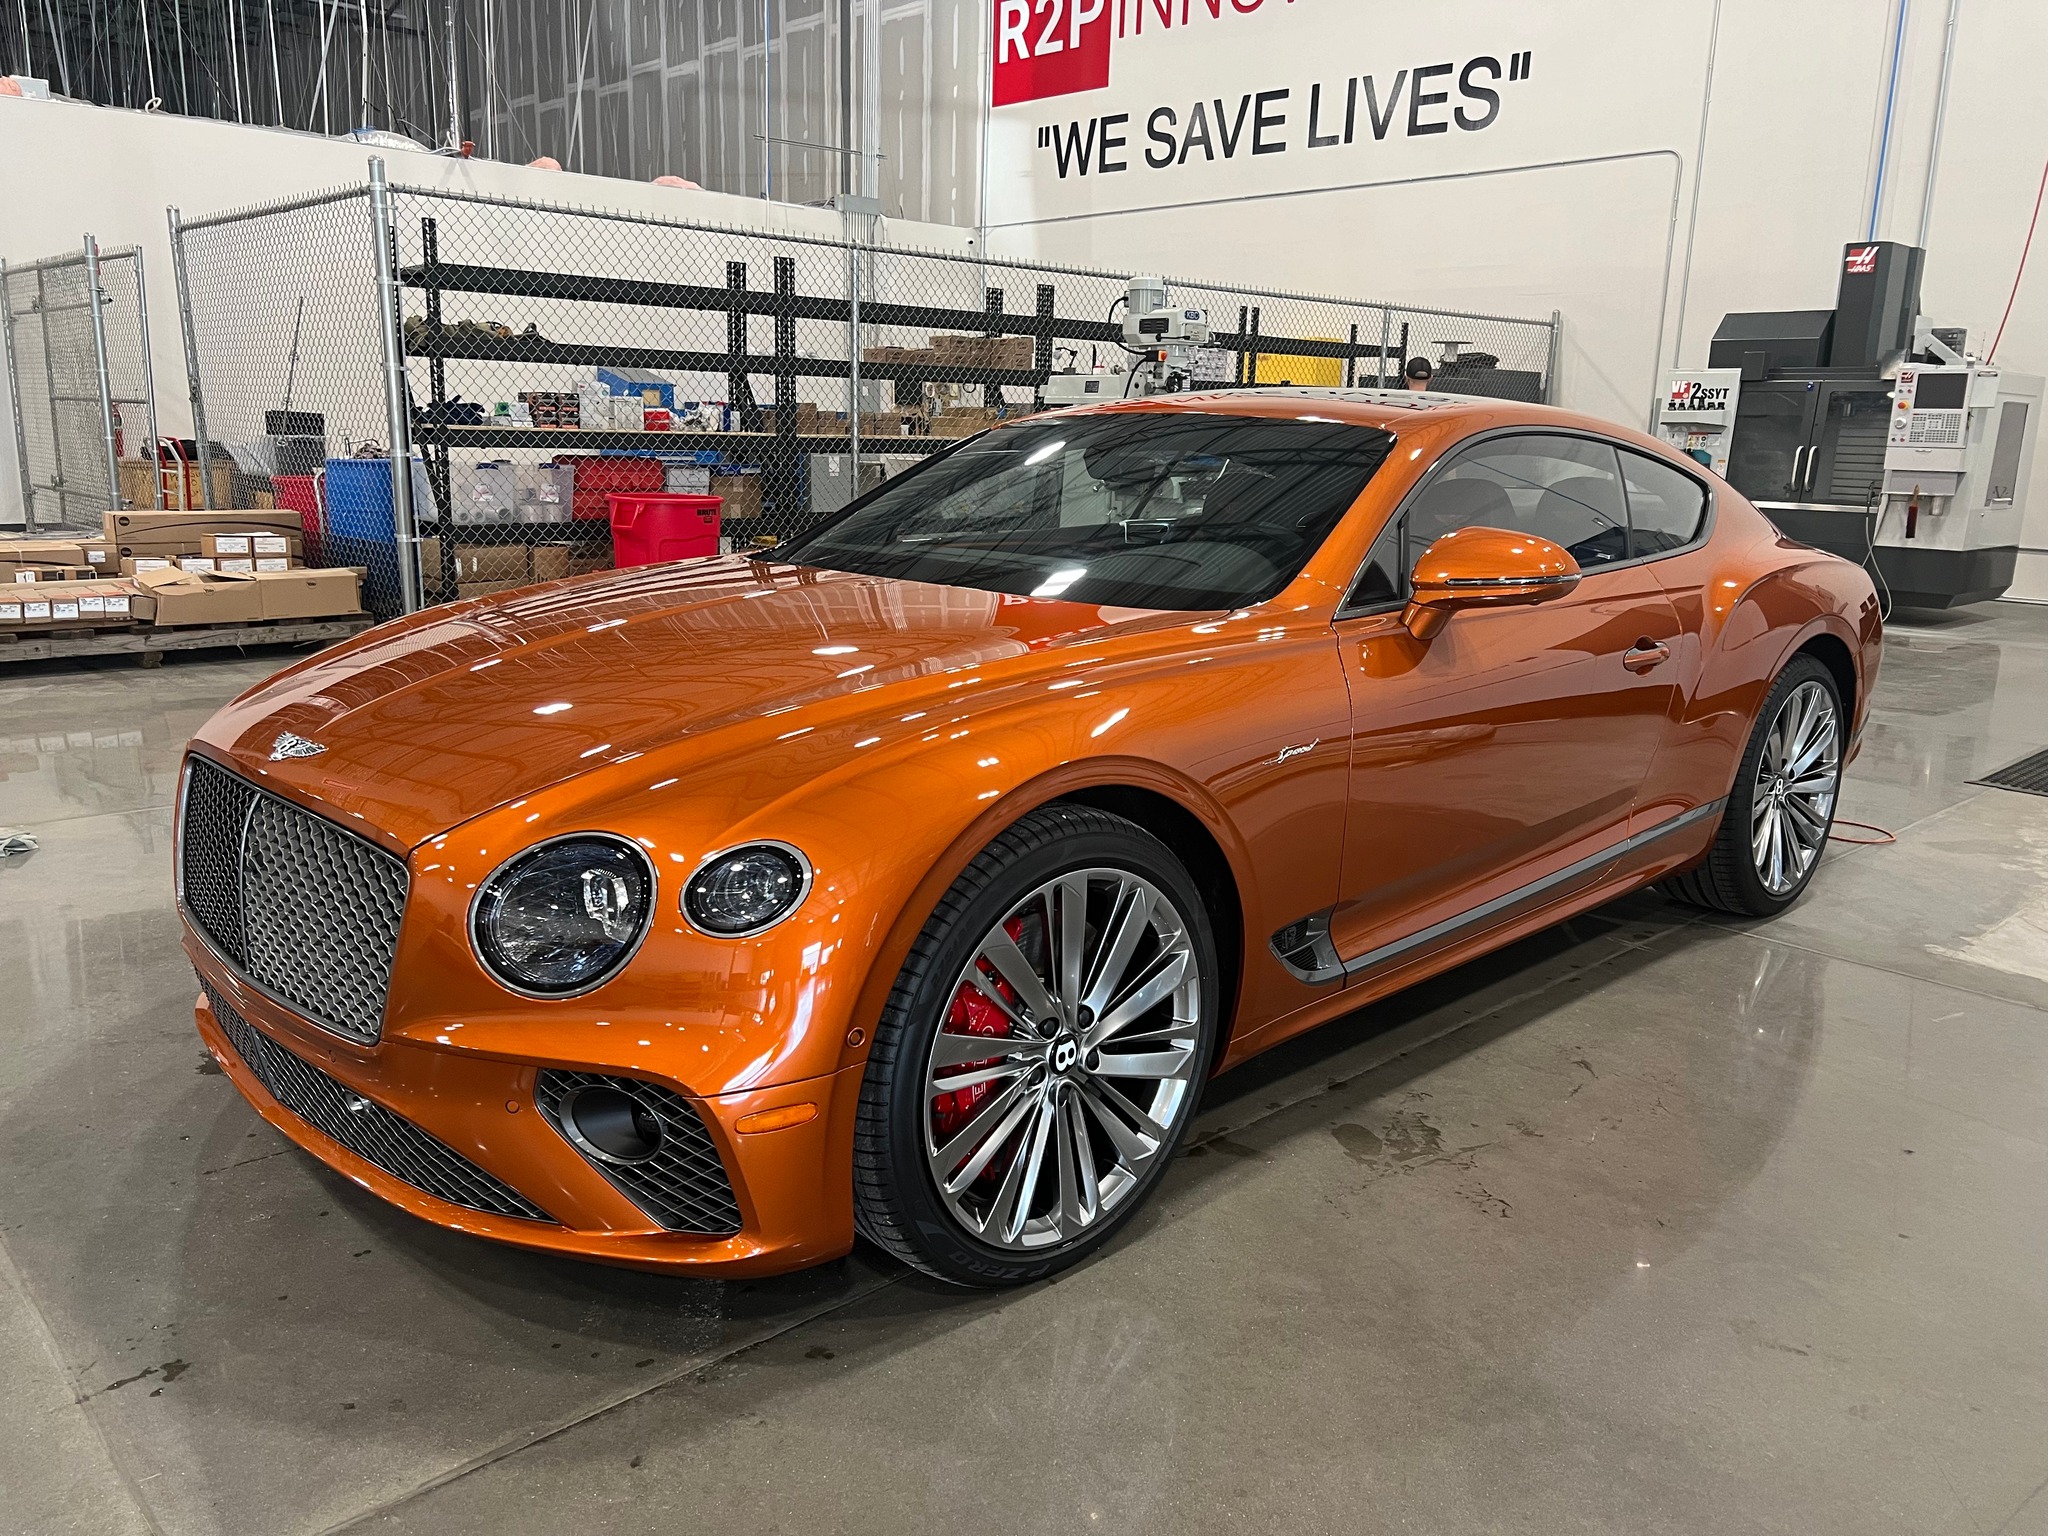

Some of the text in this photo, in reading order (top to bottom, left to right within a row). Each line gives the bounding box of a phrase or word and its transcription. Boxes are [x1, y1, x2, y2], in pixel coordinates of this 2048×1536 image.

[998, 0, 1105, 64] R2P
[1037, 50, 1532, 178] "WE SAVE LIVES"
